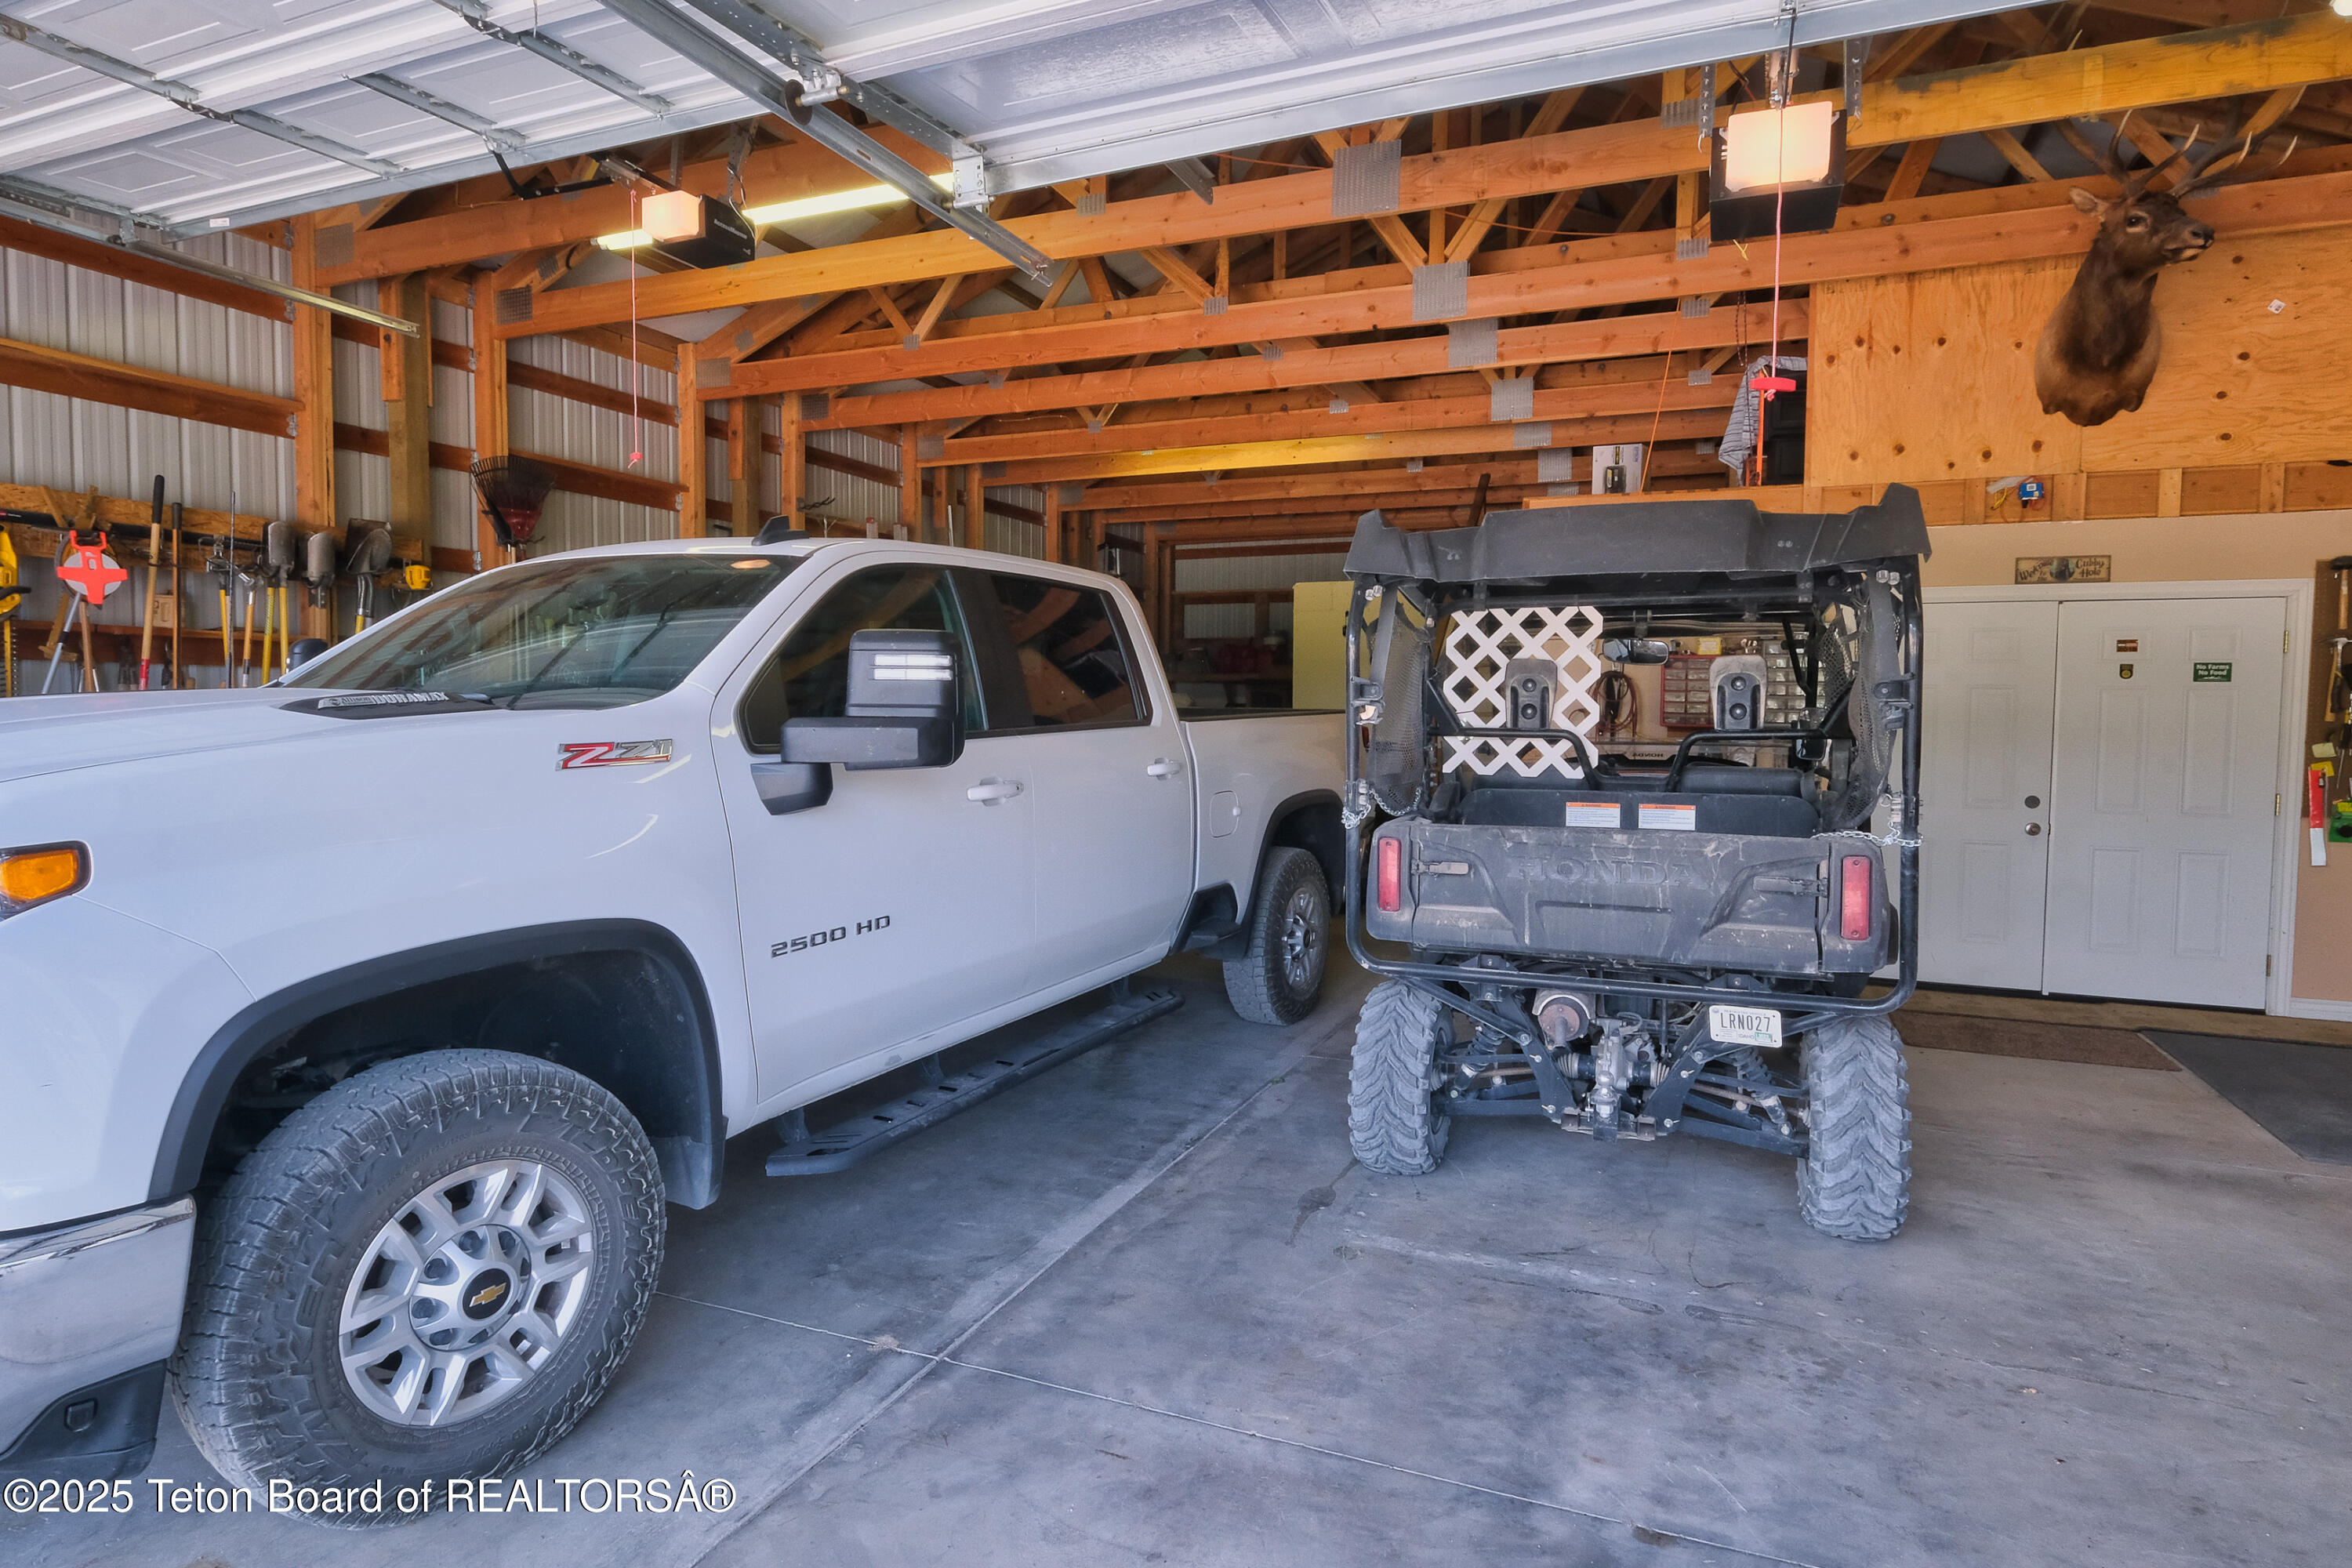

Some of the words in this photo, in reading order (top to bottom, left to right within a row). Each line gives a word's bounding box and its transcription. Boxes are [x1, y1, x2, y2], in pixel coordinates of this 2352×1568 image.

[374, 691, 449, 704] DURAMAX
[1506, 856, 1710, 890] HONDA
[771, 926, 847, 958] 2500
[855, 915, 891, 935] HD
[1720, 1012, 1770, 1032] LRN027
